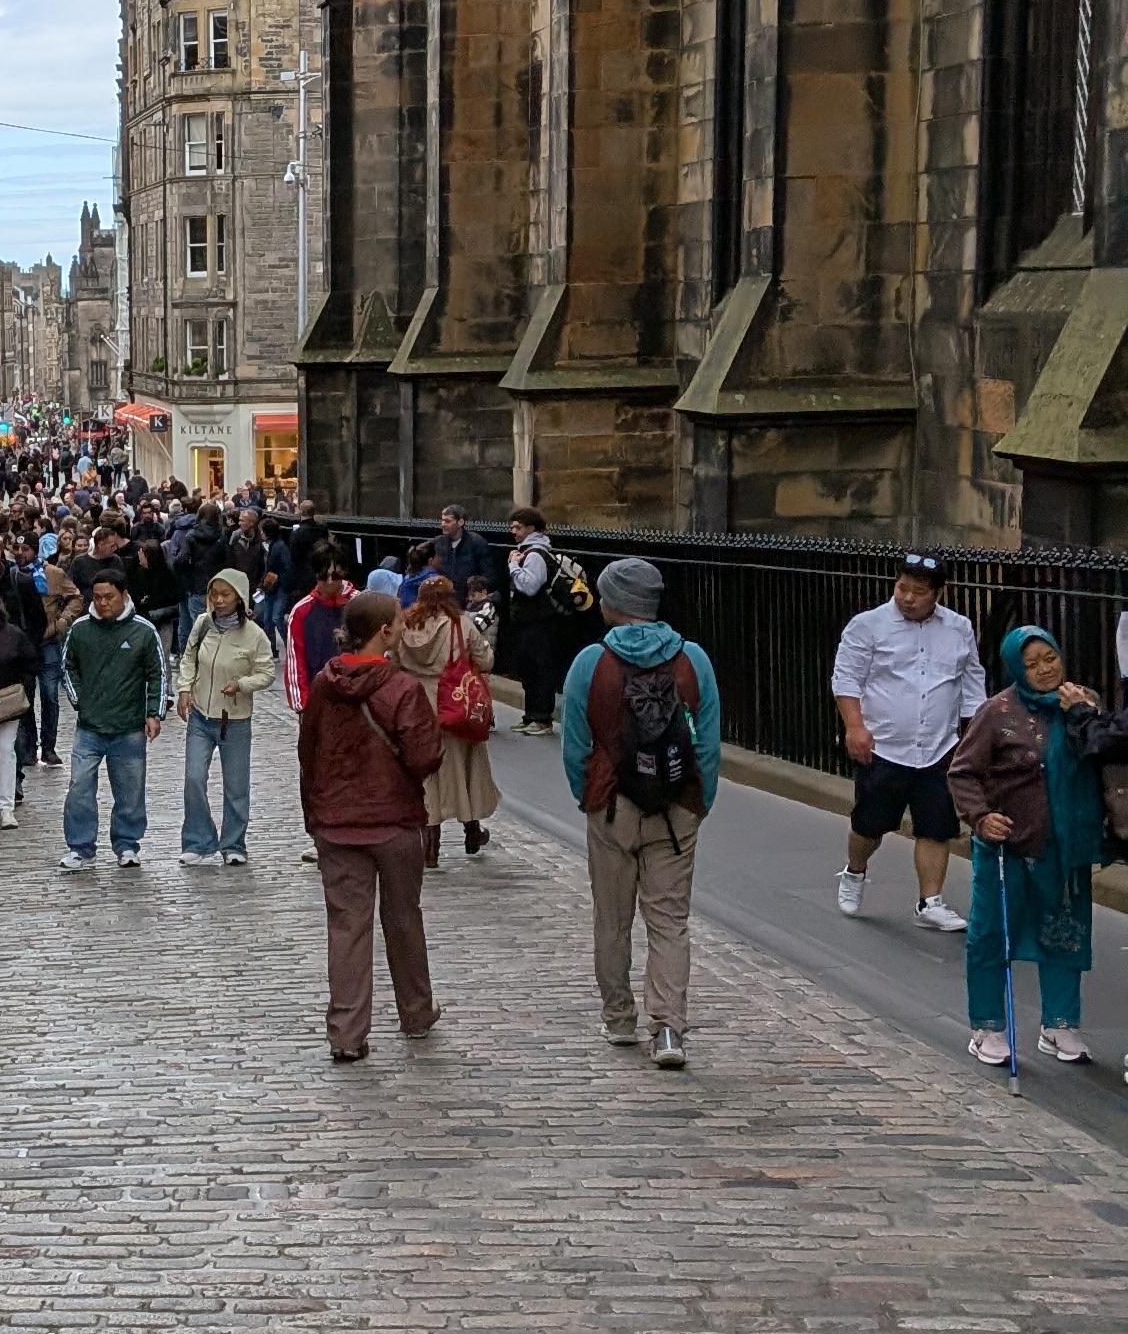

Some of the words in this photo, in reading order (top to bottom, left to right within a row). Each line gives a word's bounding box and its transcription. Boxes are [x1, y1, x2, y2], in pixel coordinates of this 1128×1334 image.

[100, 406, 110, 417] K
[154, 416, 163, 427] K
[180, 425, 232, 435] KILTANE
